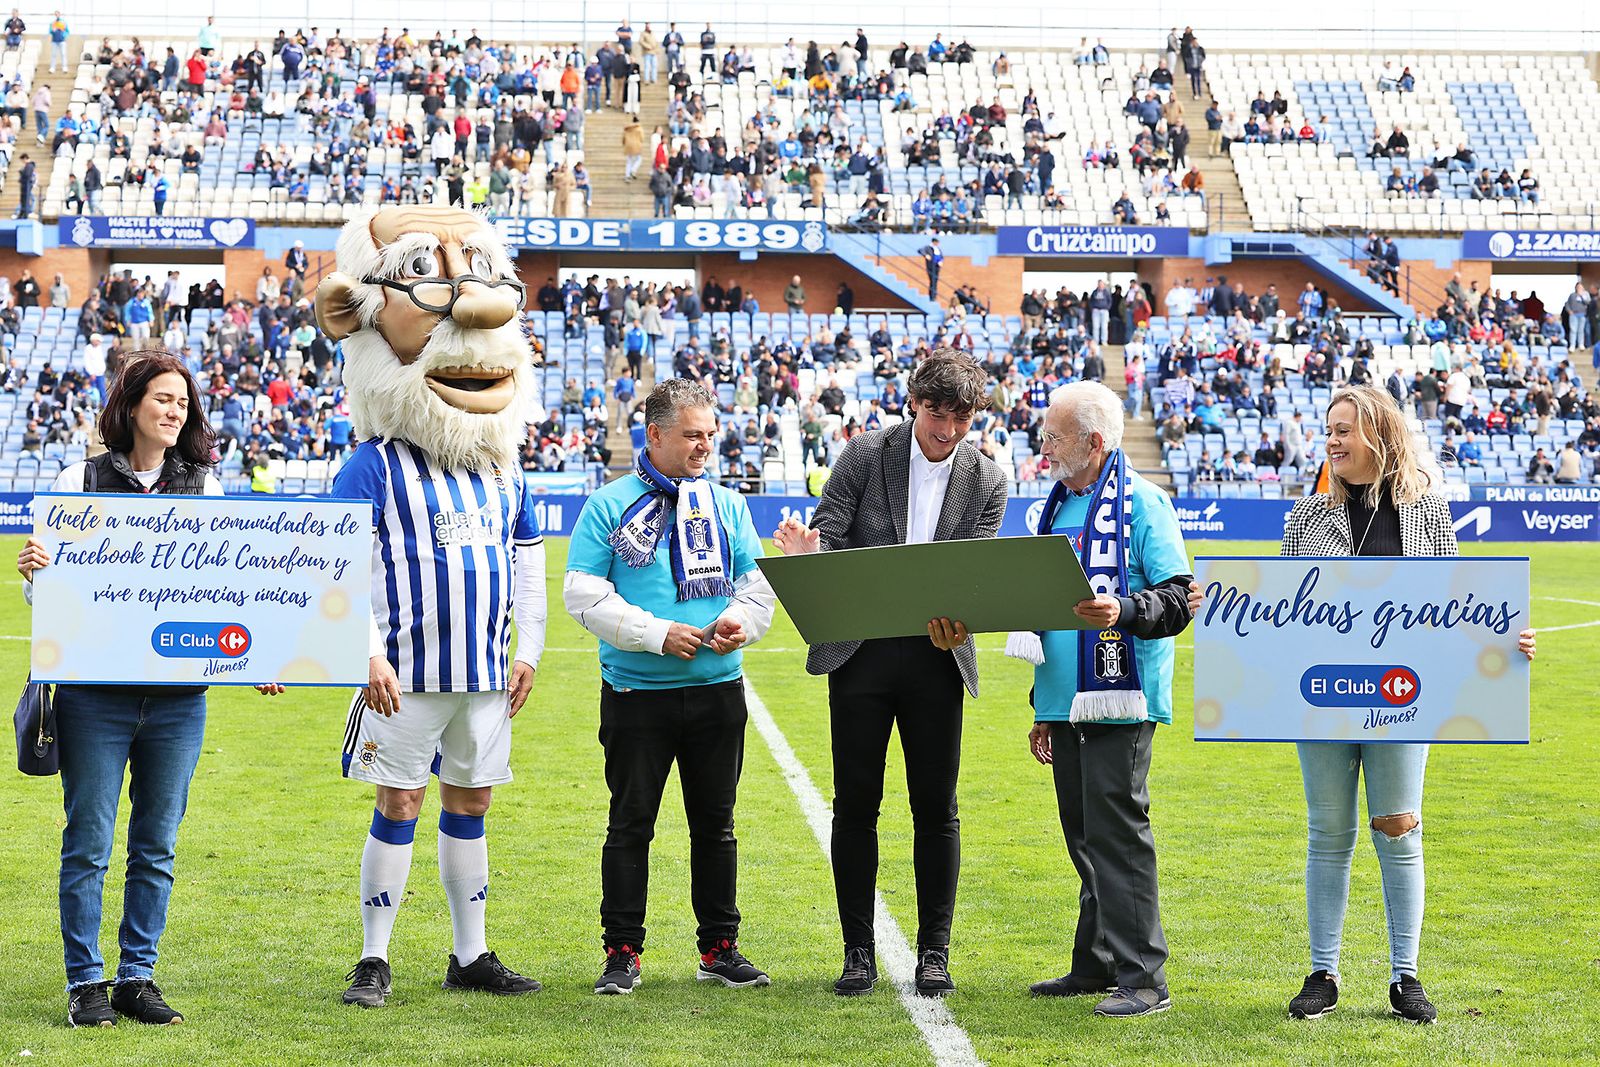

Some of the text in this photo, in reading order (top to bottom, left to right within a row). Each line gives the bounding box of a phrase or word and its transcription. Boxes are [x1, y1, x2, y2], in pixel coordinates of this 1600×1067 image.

[108, 216, 205, 228] HAZTE DONANTE
[110, 228, 203, 239] REGALA VIDA
[495, 218, 800, 250] ESDE 1889
[1026, 226, 1157, 257] Cruzcampo
[1485, 487, 1526, 502] PLAN
[1528, 490, 1544, 502] de
[1545, 487, 1600, 502] IGUALD
[46, 504, 360, 537] Únete a nuestras comunidades de
[536, 500, 563, 531] ÓN
[1177, 507, 1201, 520] lter
[1521, 509, 1594, 535] Veyser
[1180, 520, 1225, 532] nersun
[53, 537, 352, 581] Facebook El Club Carrefour y
[688, 566, 722, 576] DECANO
[93, 583, 312, 612] vive experiencias únicas
[1204, 566, 1522, 650] Muchas gracias
[160, 633, 215, 648] El Club
[202, 656, 249, 677] ¿Vienes?
[1311, 678, 1376, 695] El Club
[1362, 707, 1419, 730] ¿Vienes?
